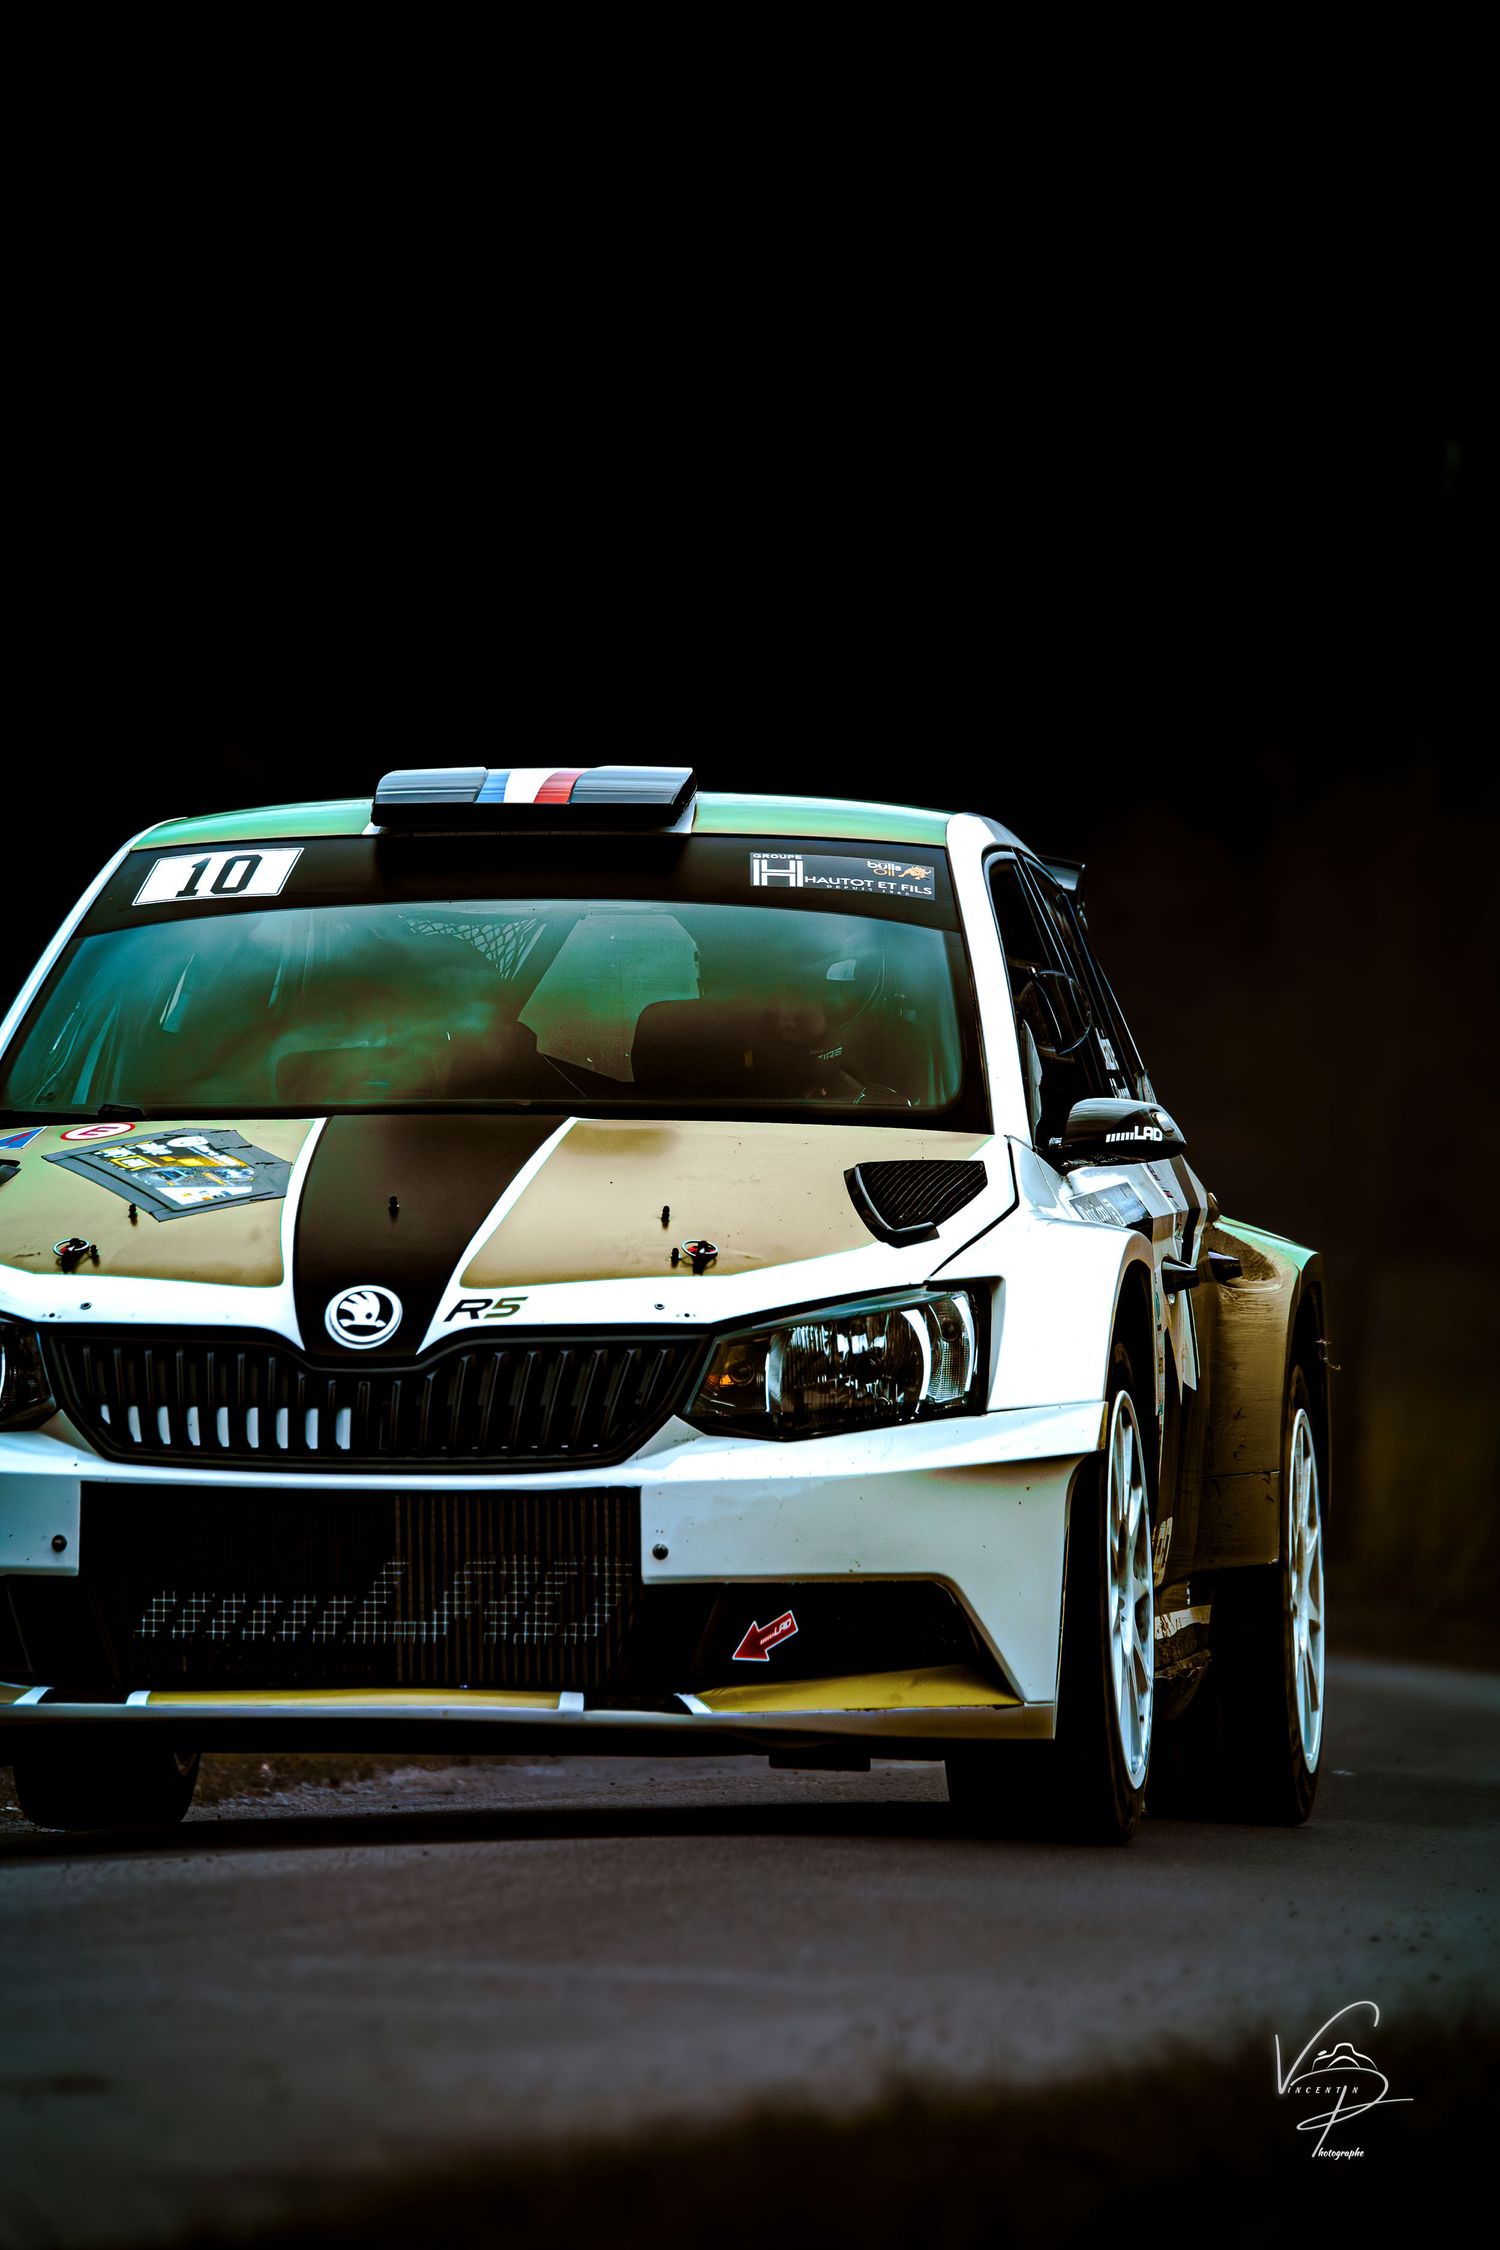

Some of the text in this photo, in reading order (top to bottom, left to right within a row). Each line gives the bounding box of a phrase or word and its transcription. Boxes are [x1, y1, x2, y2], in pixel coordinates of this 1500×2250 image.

[752, 852, 803, 860] GROUPE
[175, 854, 263, 898] 10
[804, 876, 933, 895] HAUTOT ET FILS
[443, 1296, 529, 1323] R5
